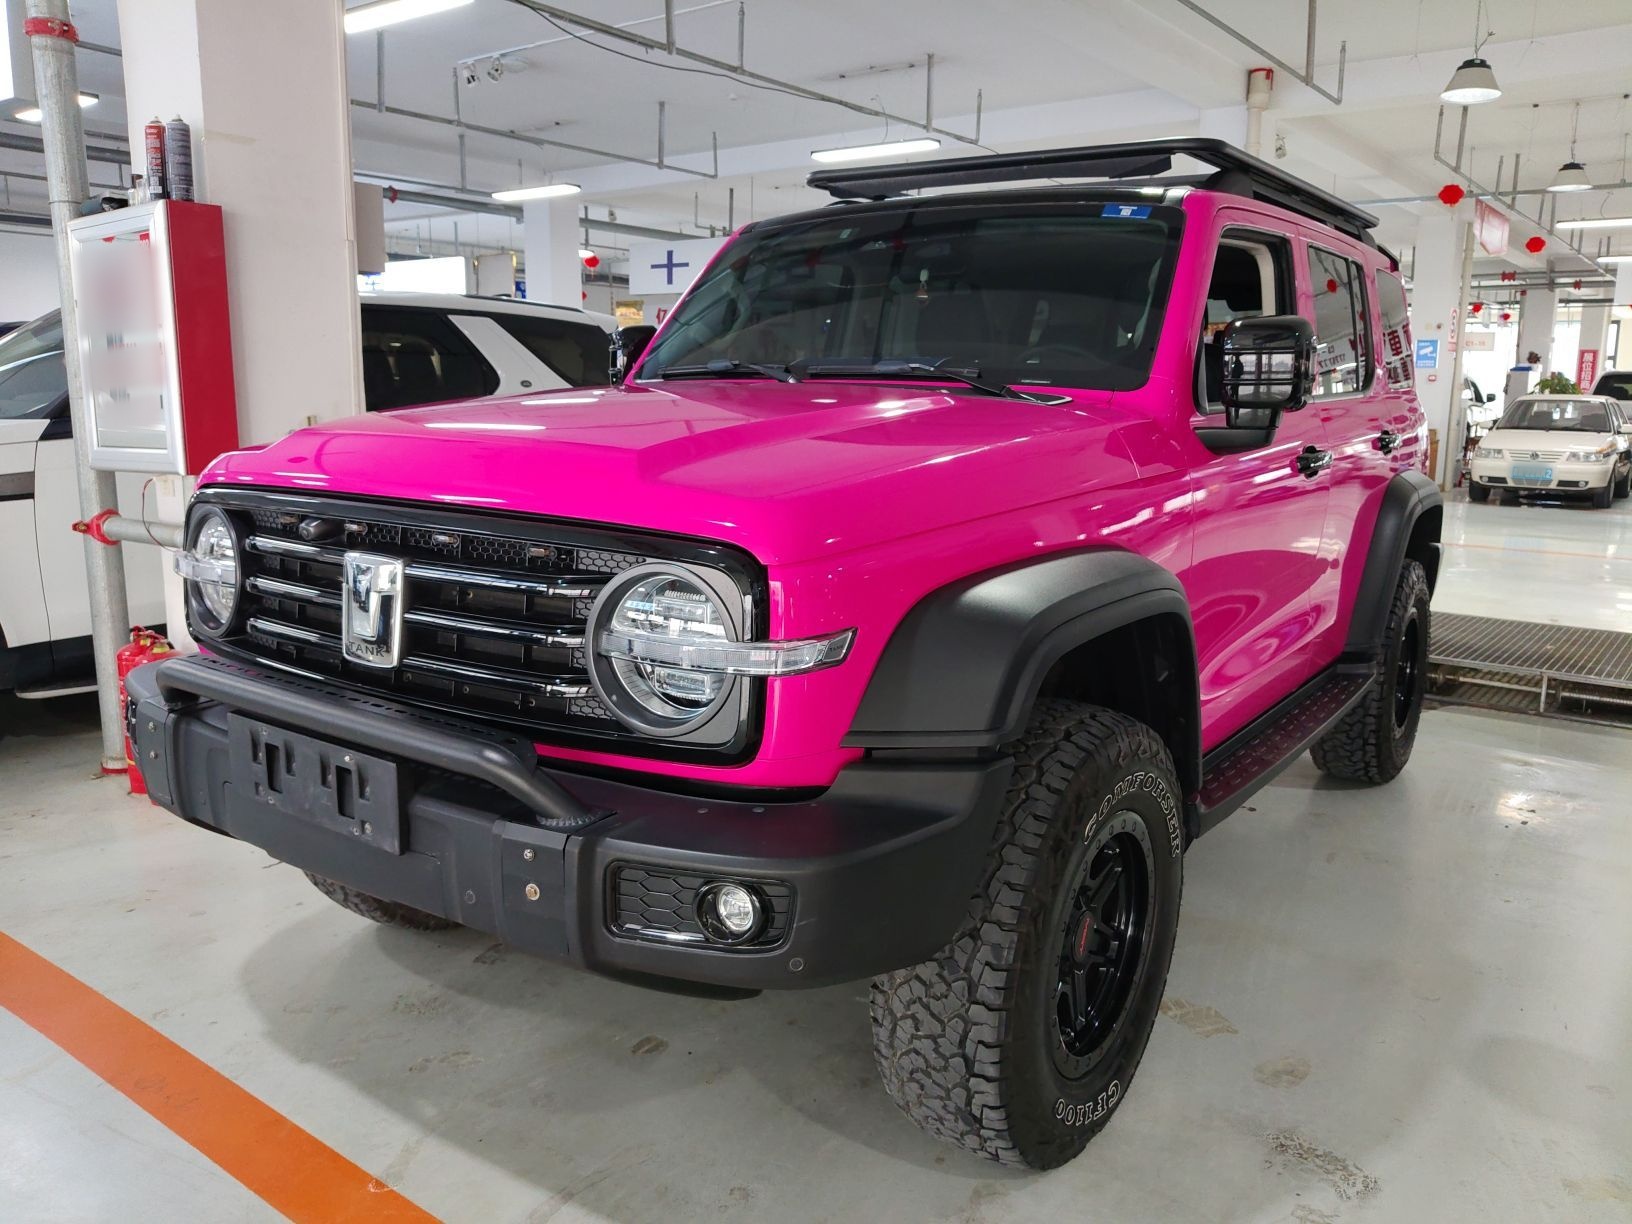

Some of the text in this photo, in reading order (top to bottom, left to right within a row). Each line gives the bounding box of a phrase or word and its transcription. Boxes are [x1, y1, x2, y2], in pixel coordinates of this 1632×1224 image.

[348, 641, 385, 657] TANK
[1084, 771, 1181, 858] COMFORSER
[1055, 1080, 1121, 1127] CF1100
